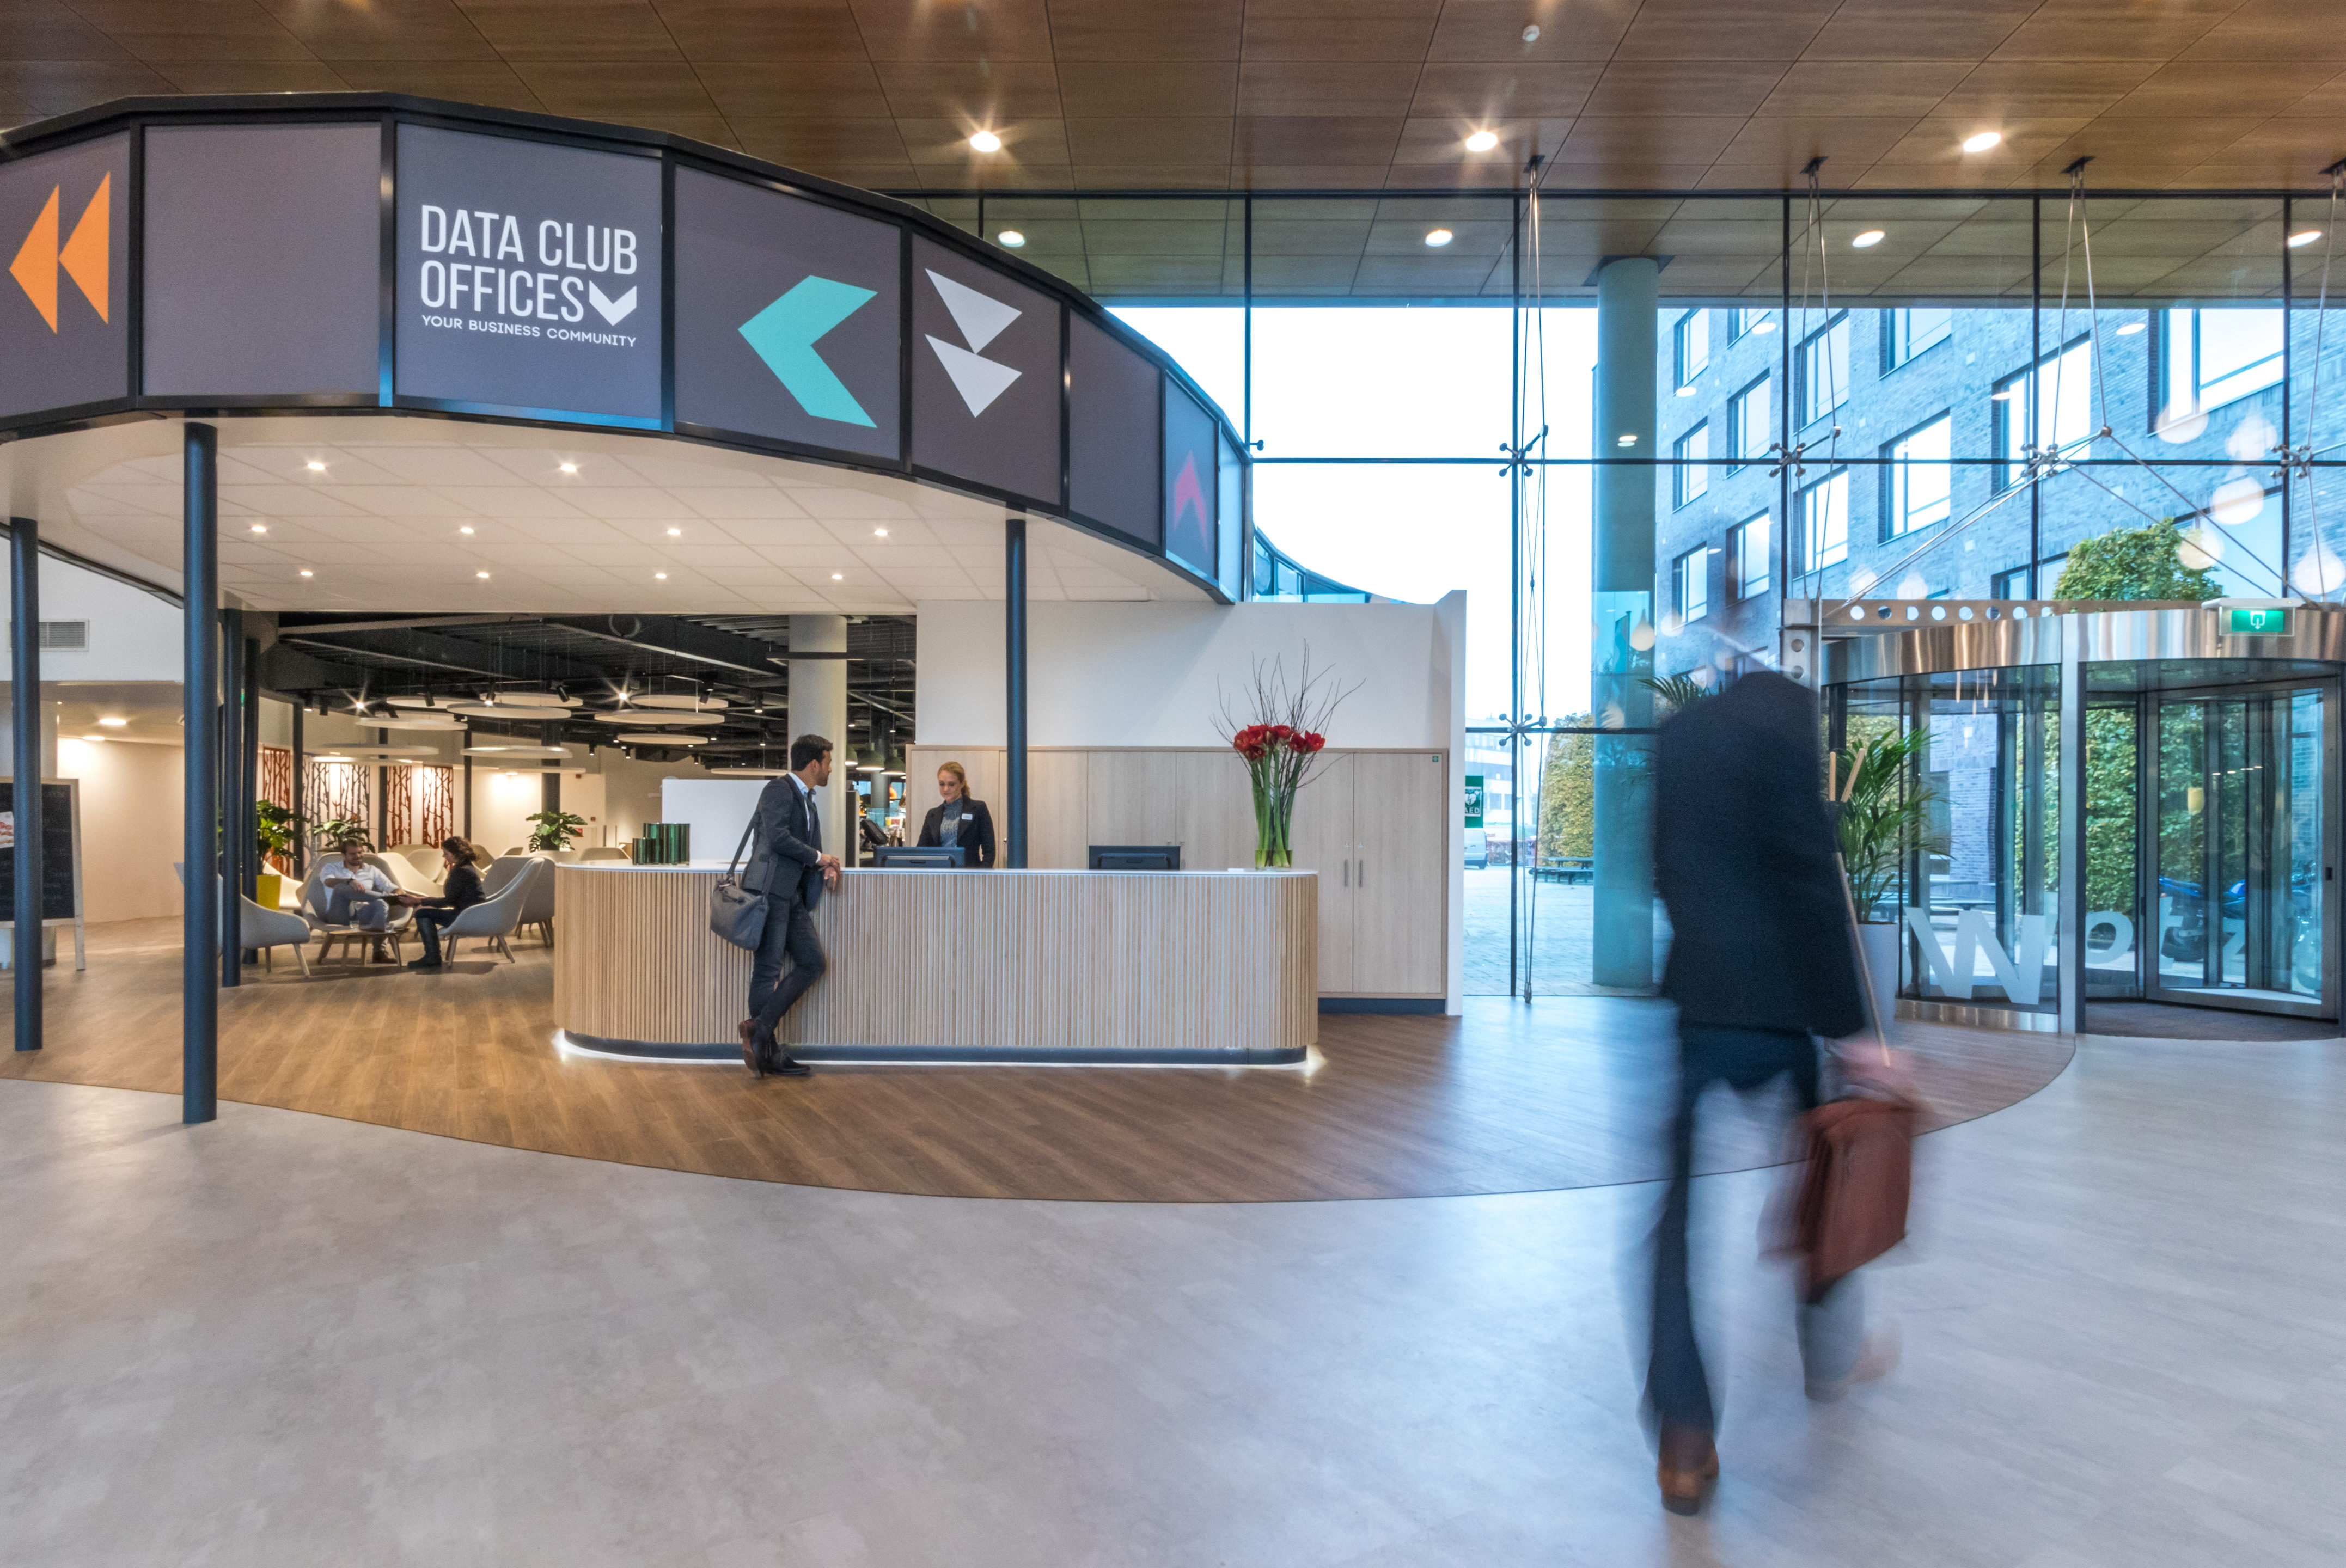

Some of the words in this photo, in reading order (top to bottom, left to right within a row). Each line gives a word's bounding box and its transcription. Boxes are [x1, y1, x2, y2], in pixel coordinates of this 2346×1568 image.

[421, 204, 524, 262] DATA
[539, 219, 637, 275] CLUB
[421, 260, 584, 322] OFFICES
[421, 314, 462, 329] YOUR
[469, 319, 541, 337] BUSINESS
[547, 328, 637, 347] COMMUNITY
